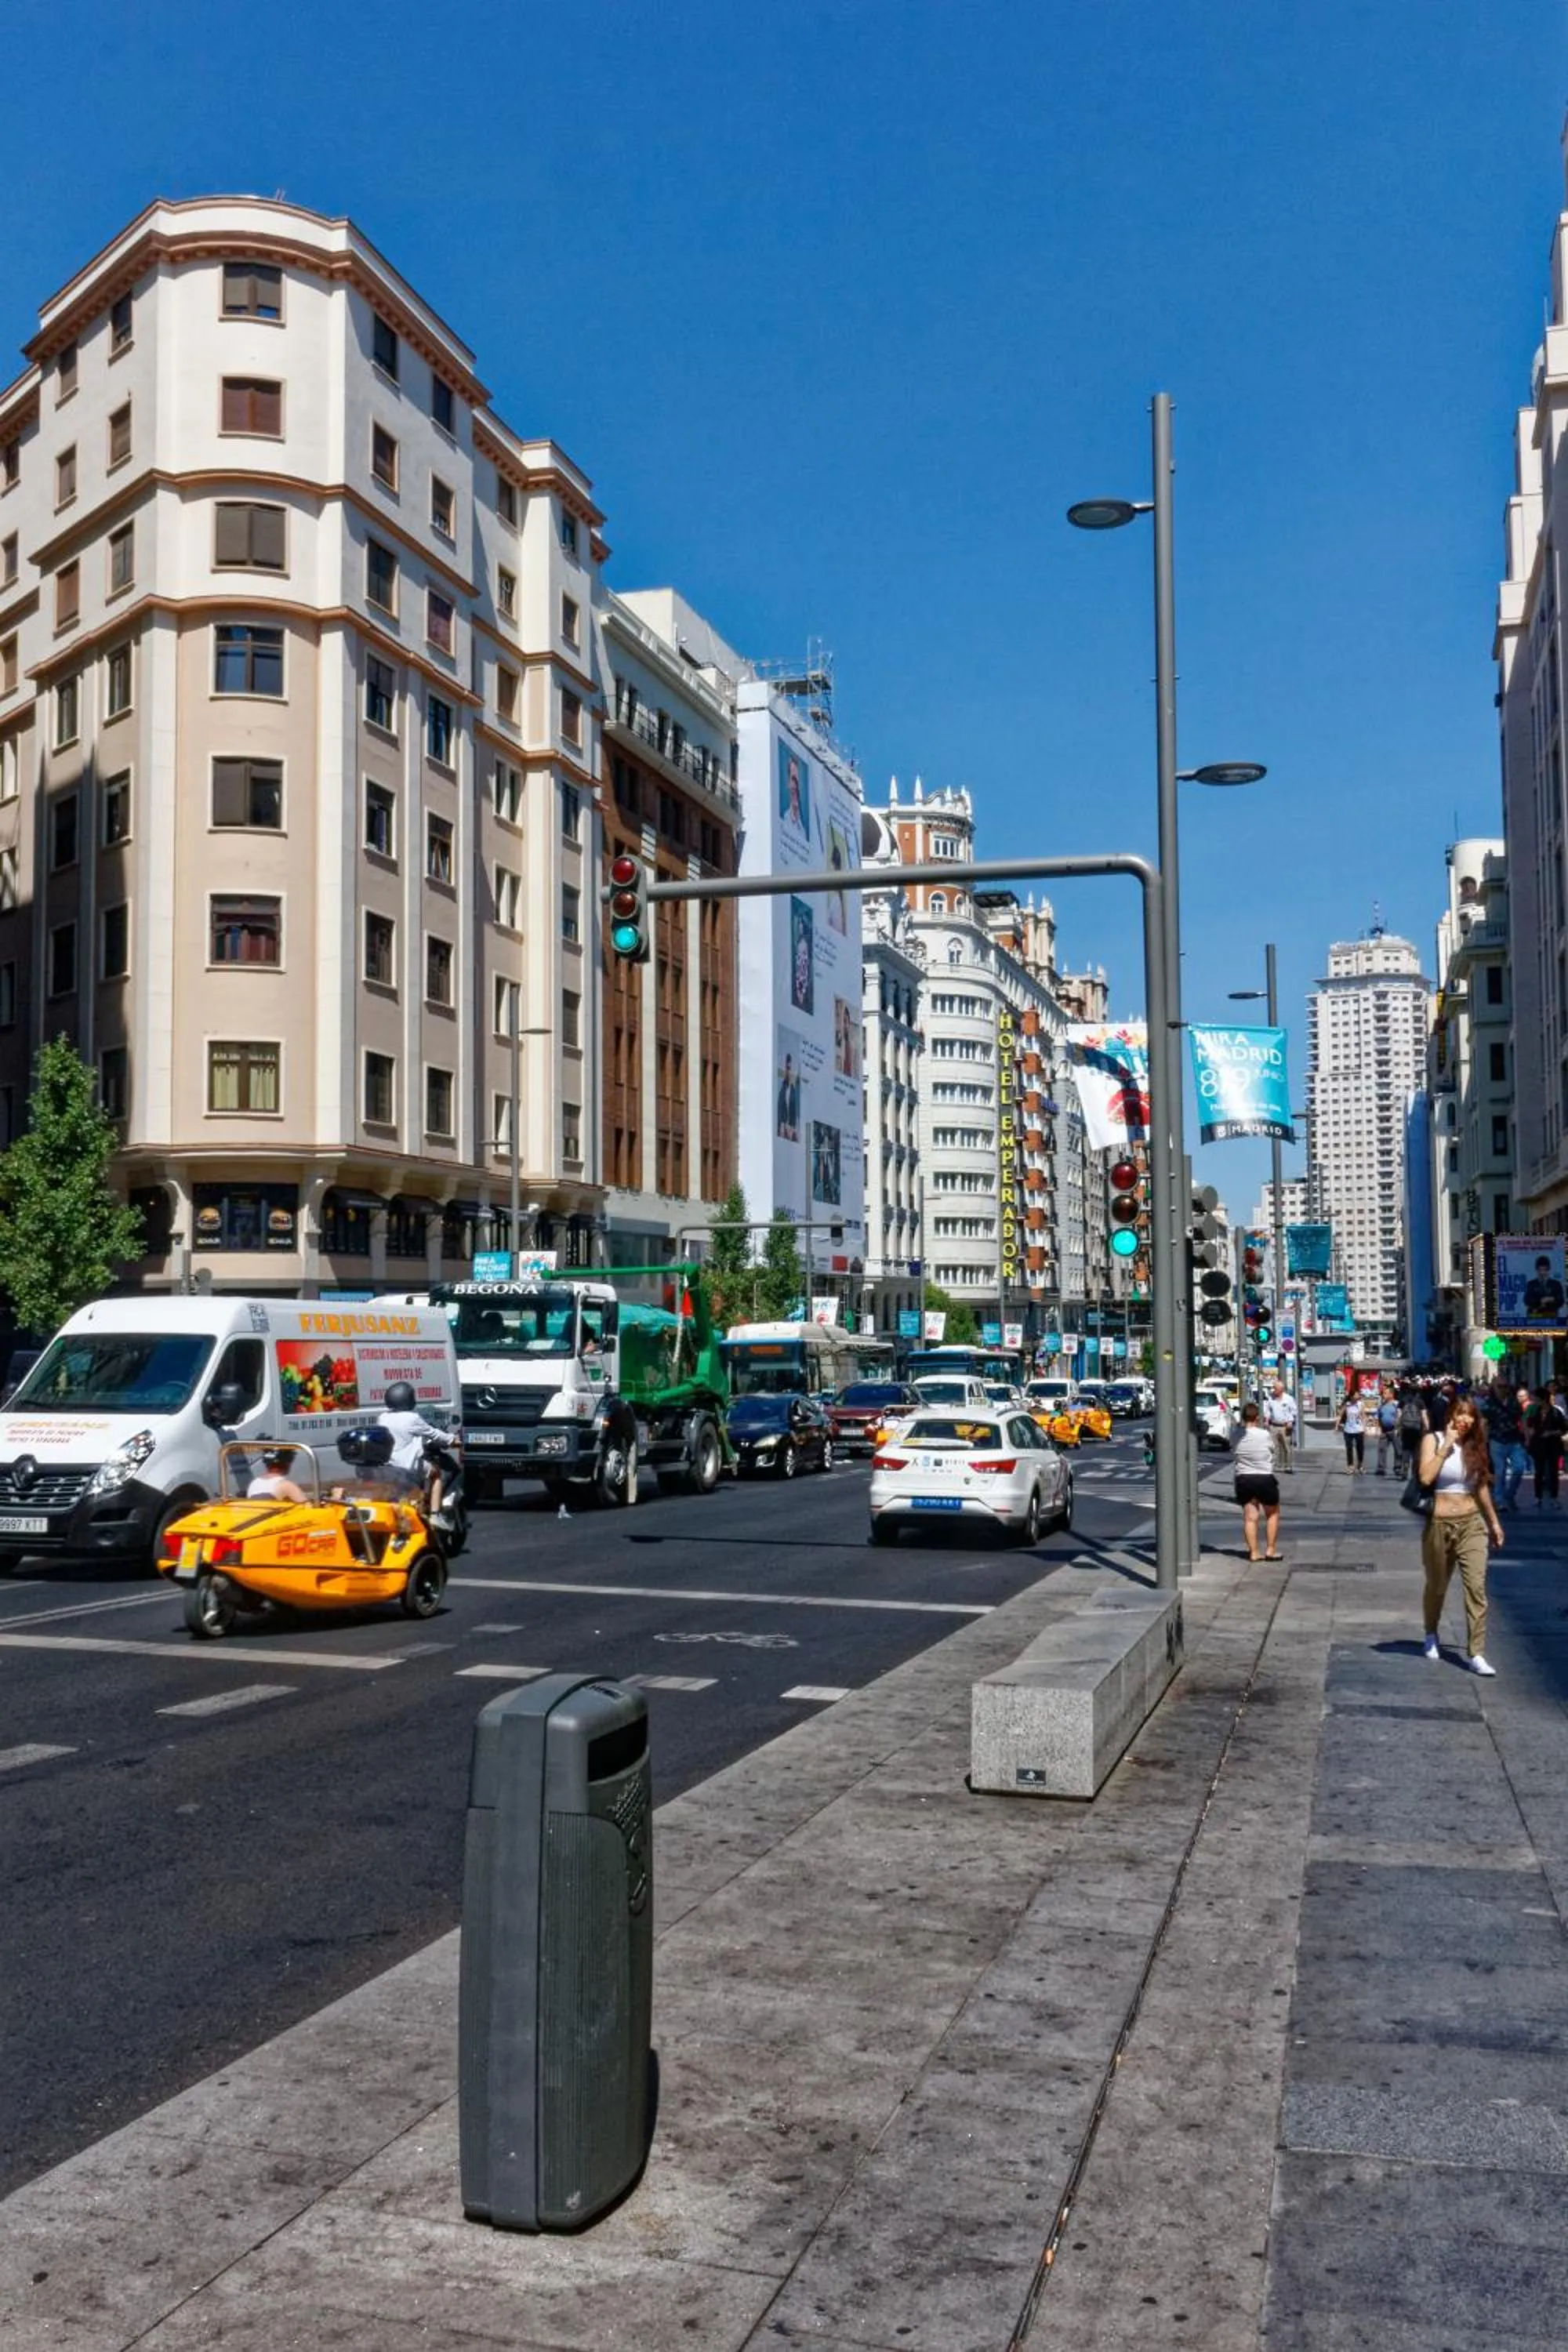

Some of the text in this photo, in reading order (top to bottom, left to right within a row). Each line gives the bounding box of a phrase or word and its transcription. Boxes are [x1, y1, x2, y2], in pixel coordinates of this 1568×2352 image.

[1196, 1031, 1249, 1046] MIRA
[1197, 1047, 1283, 1065] MADRID
[1232, 1123, 1283, 1136] MADRID
[998, 1014, 1017, 1277] HOTEL EMPERADOR
[453, 1282, 539, 1294] BEGOÑA
[299, 1312, 421, 1335] FERJUSANZ
